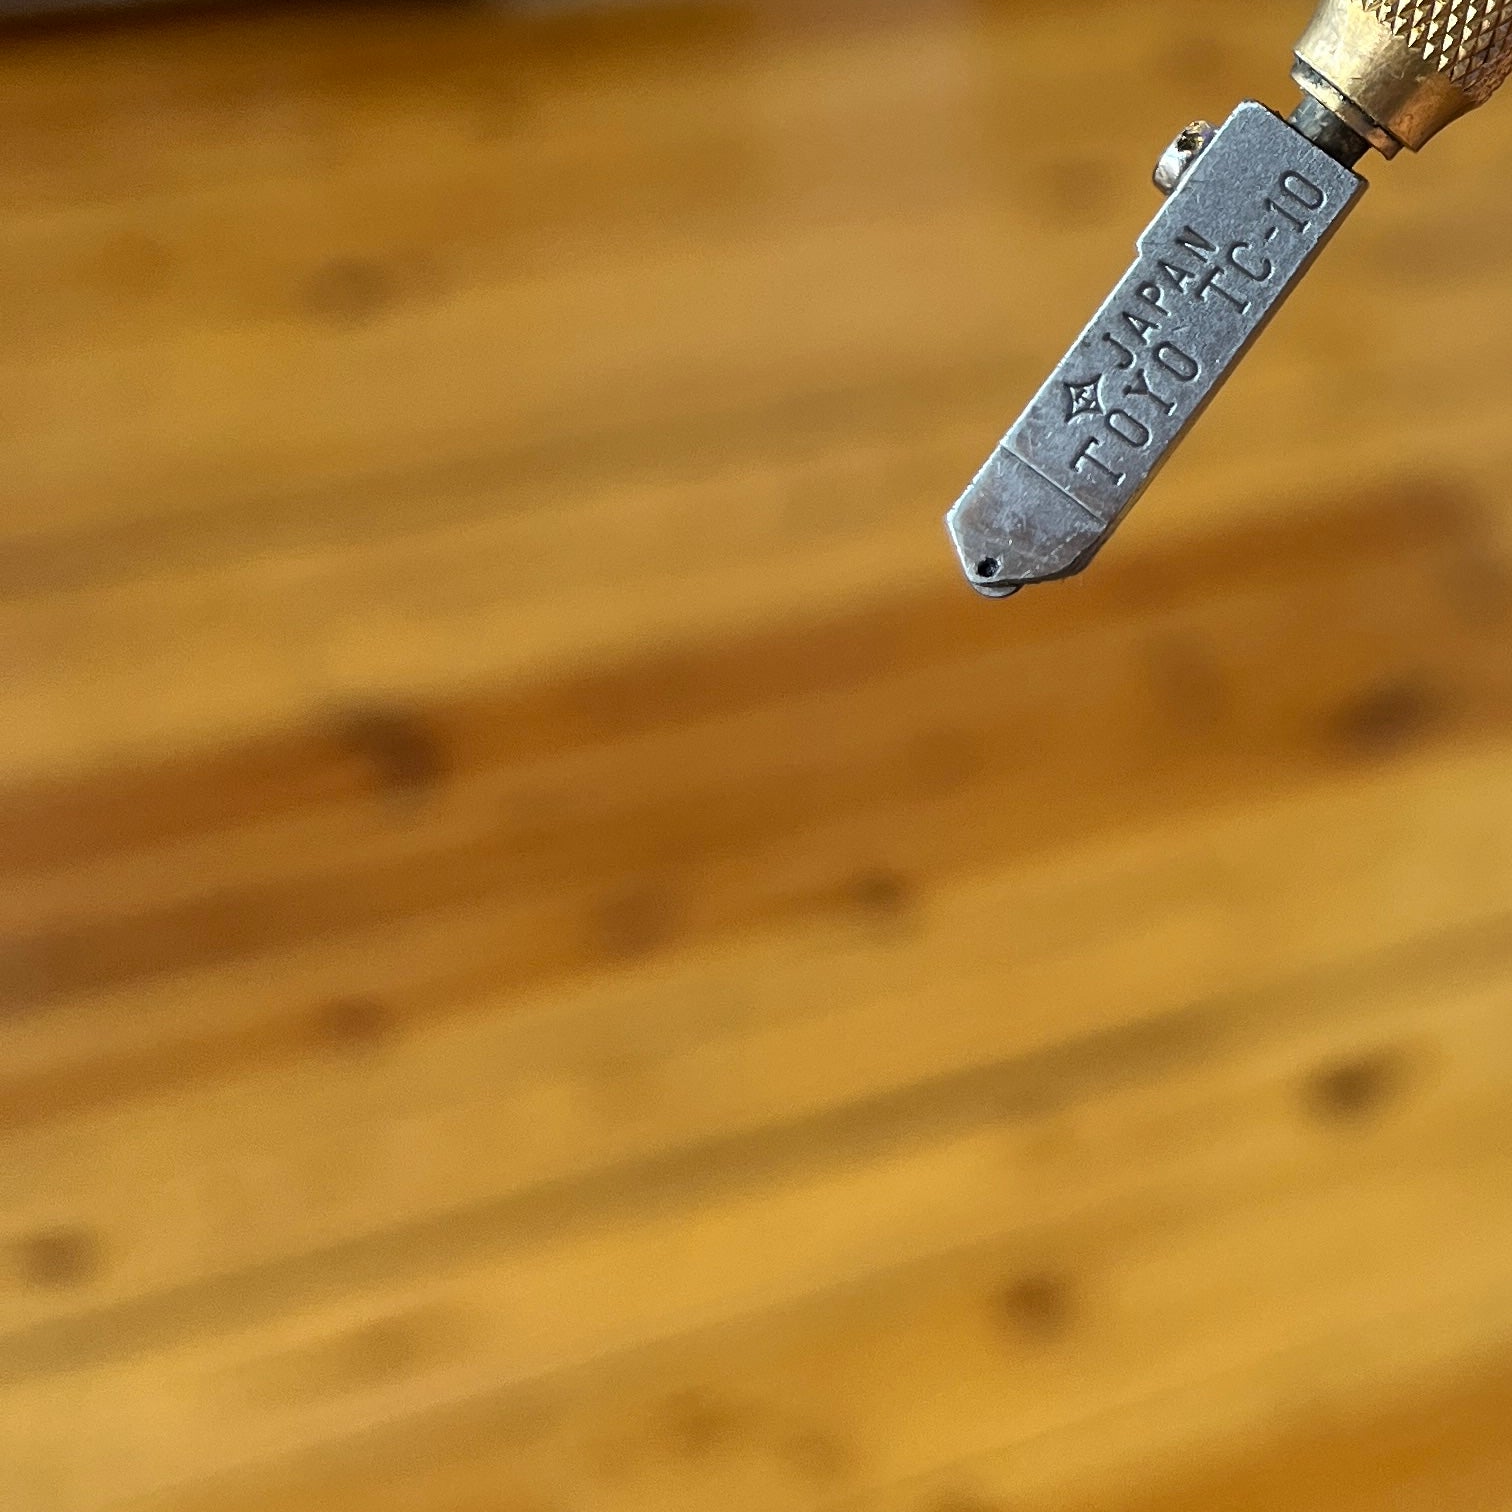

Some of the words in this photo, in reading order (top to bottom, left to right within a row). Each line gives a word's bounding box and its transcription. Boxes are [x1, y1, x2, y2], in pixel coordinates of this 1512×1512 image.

[1069, 340, 1201, 486] TOYO
[1195, 169, 1328, 316] TC-10
[1102, 225, 1219, 370] JAPAN
